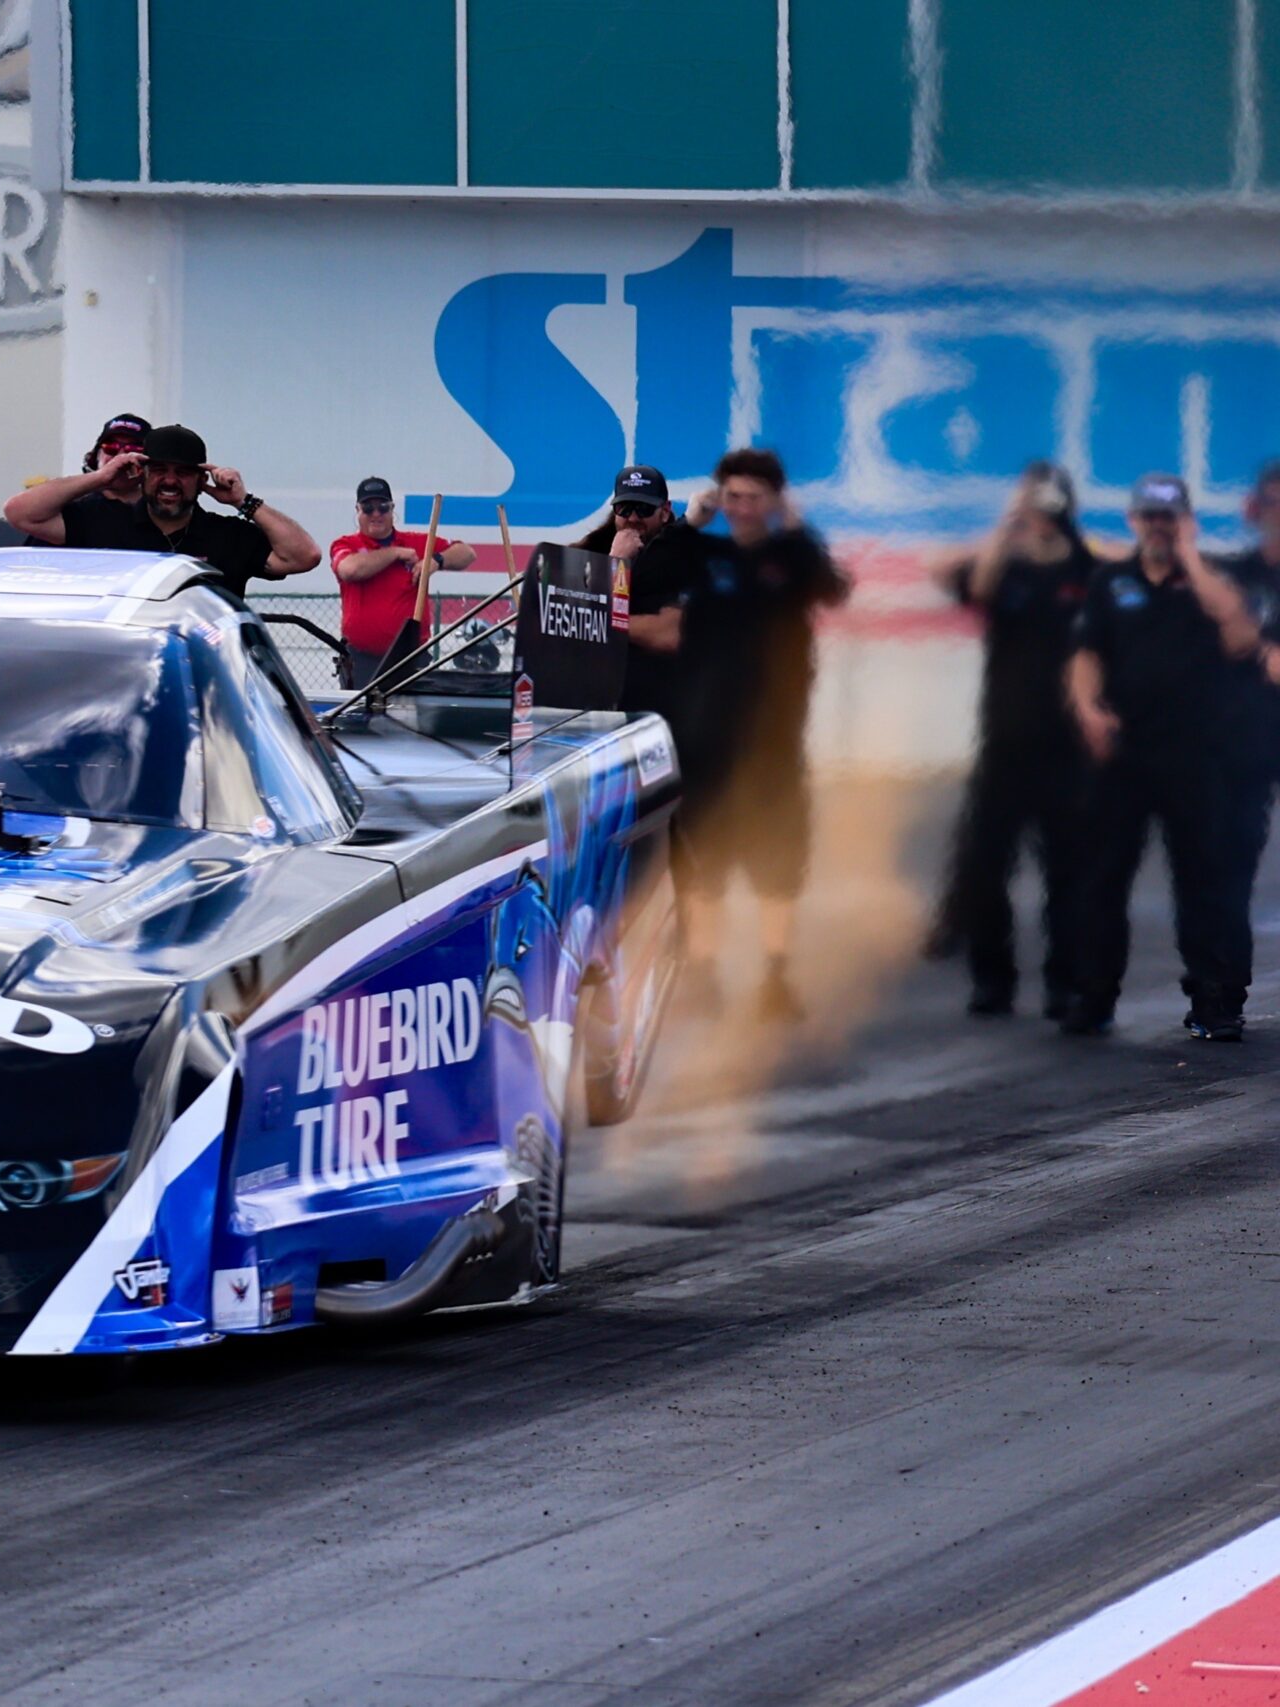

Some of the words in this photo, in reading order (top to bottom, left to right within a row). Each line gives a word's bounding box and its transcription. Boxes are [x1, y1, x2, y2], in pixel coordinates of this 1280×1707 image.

[538, 582, 607, 644] VERSATRAN
[297, 977, 481, 1095] BLUEBIRD
[293, 1089, 409, 1192] TURF
